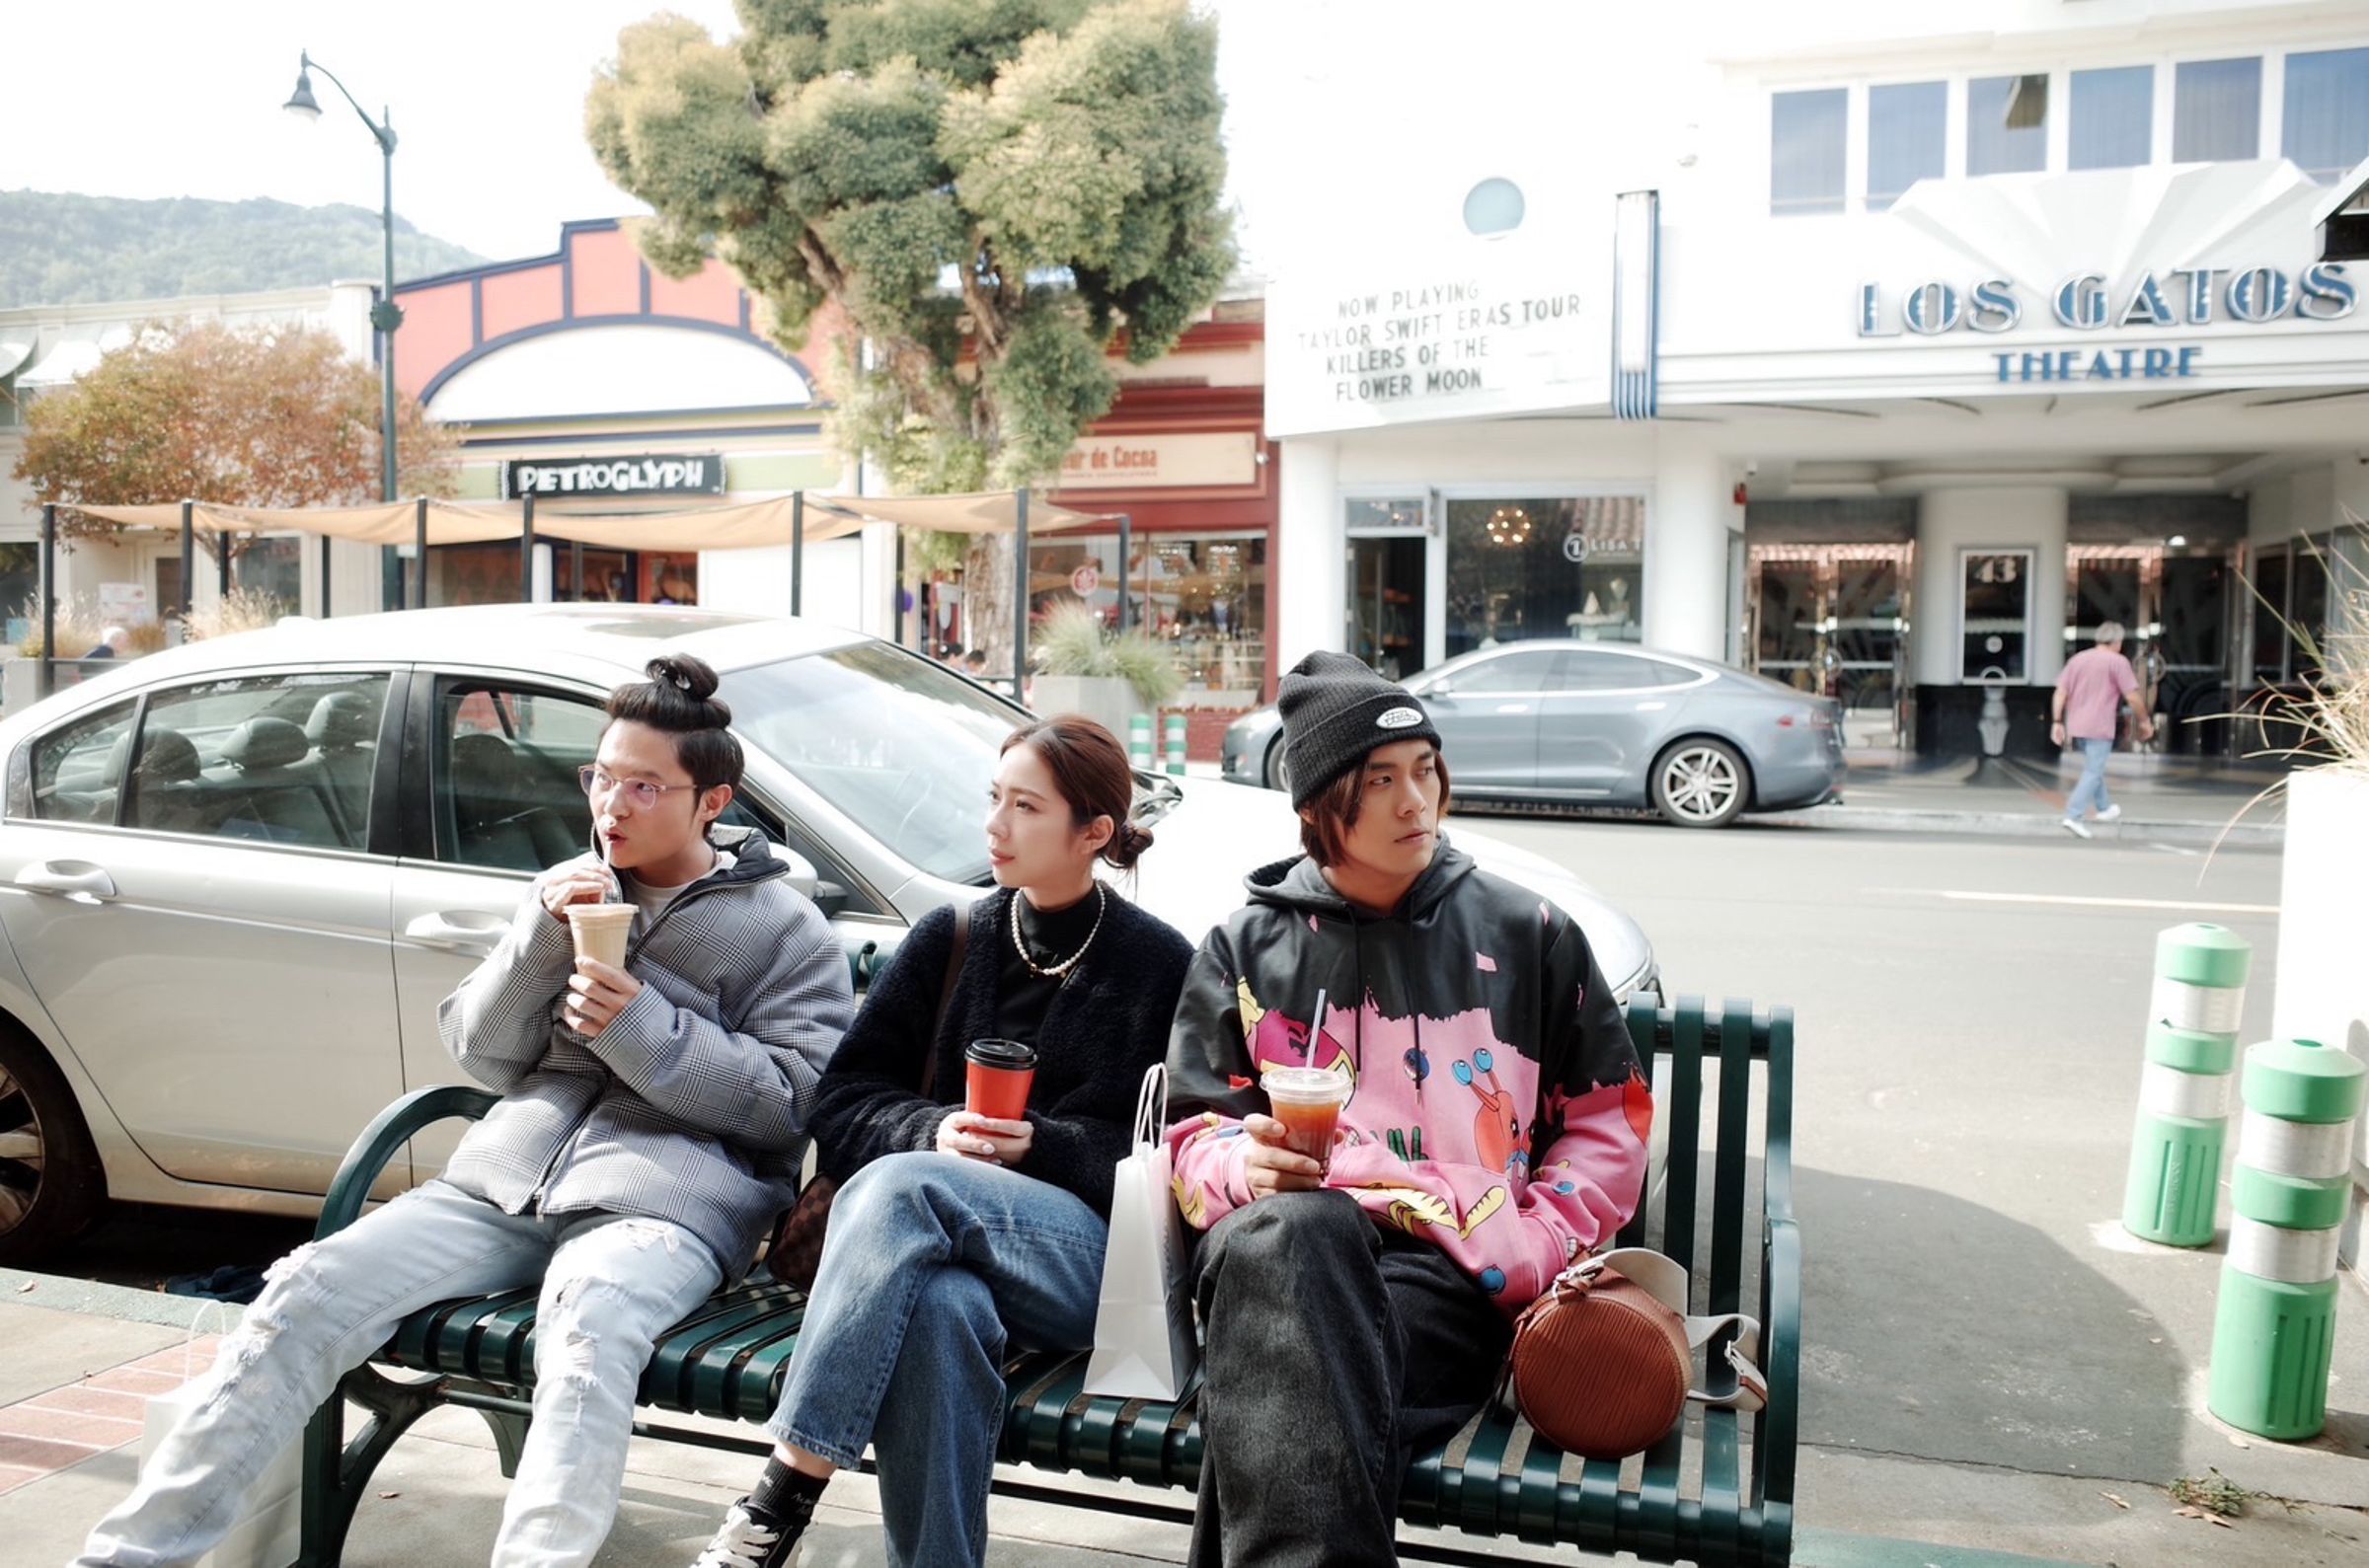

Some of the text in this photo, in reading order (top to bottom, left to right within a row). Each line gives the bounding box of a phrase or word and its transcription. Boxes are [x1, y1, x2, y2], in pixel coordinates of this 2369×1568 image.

[1338, 279, 1481, 318] NOW PLAYING
[1857, 261, 2359, 337] LOS GATOS
[1298, 293, 1581, 351] TAYLOR SWIFT ERAS TOUR
[1327, 336, 1490, 375] KILLERS OF THE
[1993, 346, 2202, 382] THEATRE
[1337, 368, 1483, 402] FLOWER MOON
[1092, 446, 1109, 469] de
[1113, 445, 1158, 469] Cocoa
[517, 460, 704, 492] PETROGLYPH
[1976, 557, 2017, 583] 43
